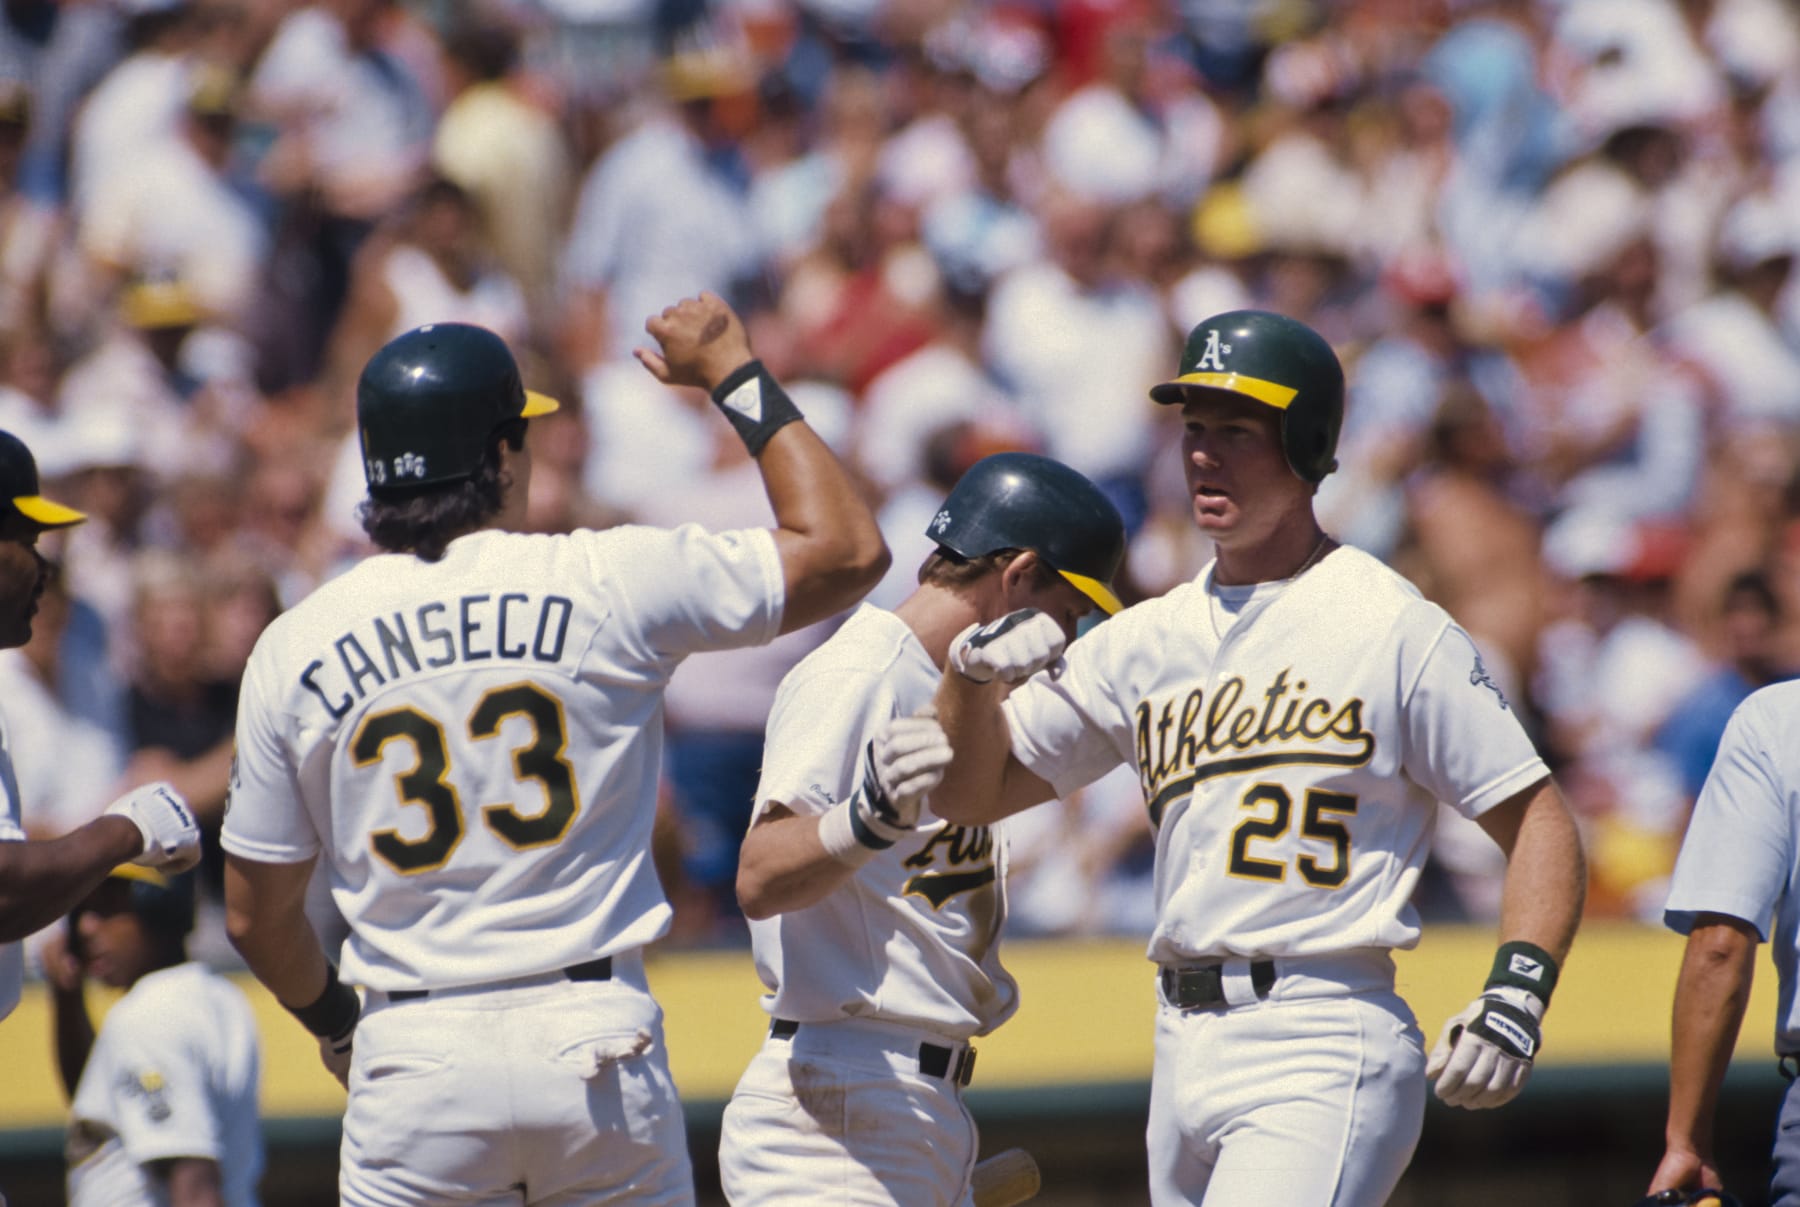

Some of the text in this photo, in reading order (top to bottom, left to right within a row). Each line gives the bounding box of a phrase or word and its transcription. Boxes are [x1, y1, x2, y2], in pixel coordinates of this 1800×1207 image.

[1195, 329, 1231, 370] A's
[300, 594, 573, 719] CANSECO
[351, 681, 581, 876] 33
[1135, 664, 1374, 793] Athletics
[1225, 781, 1361, 891] 25
